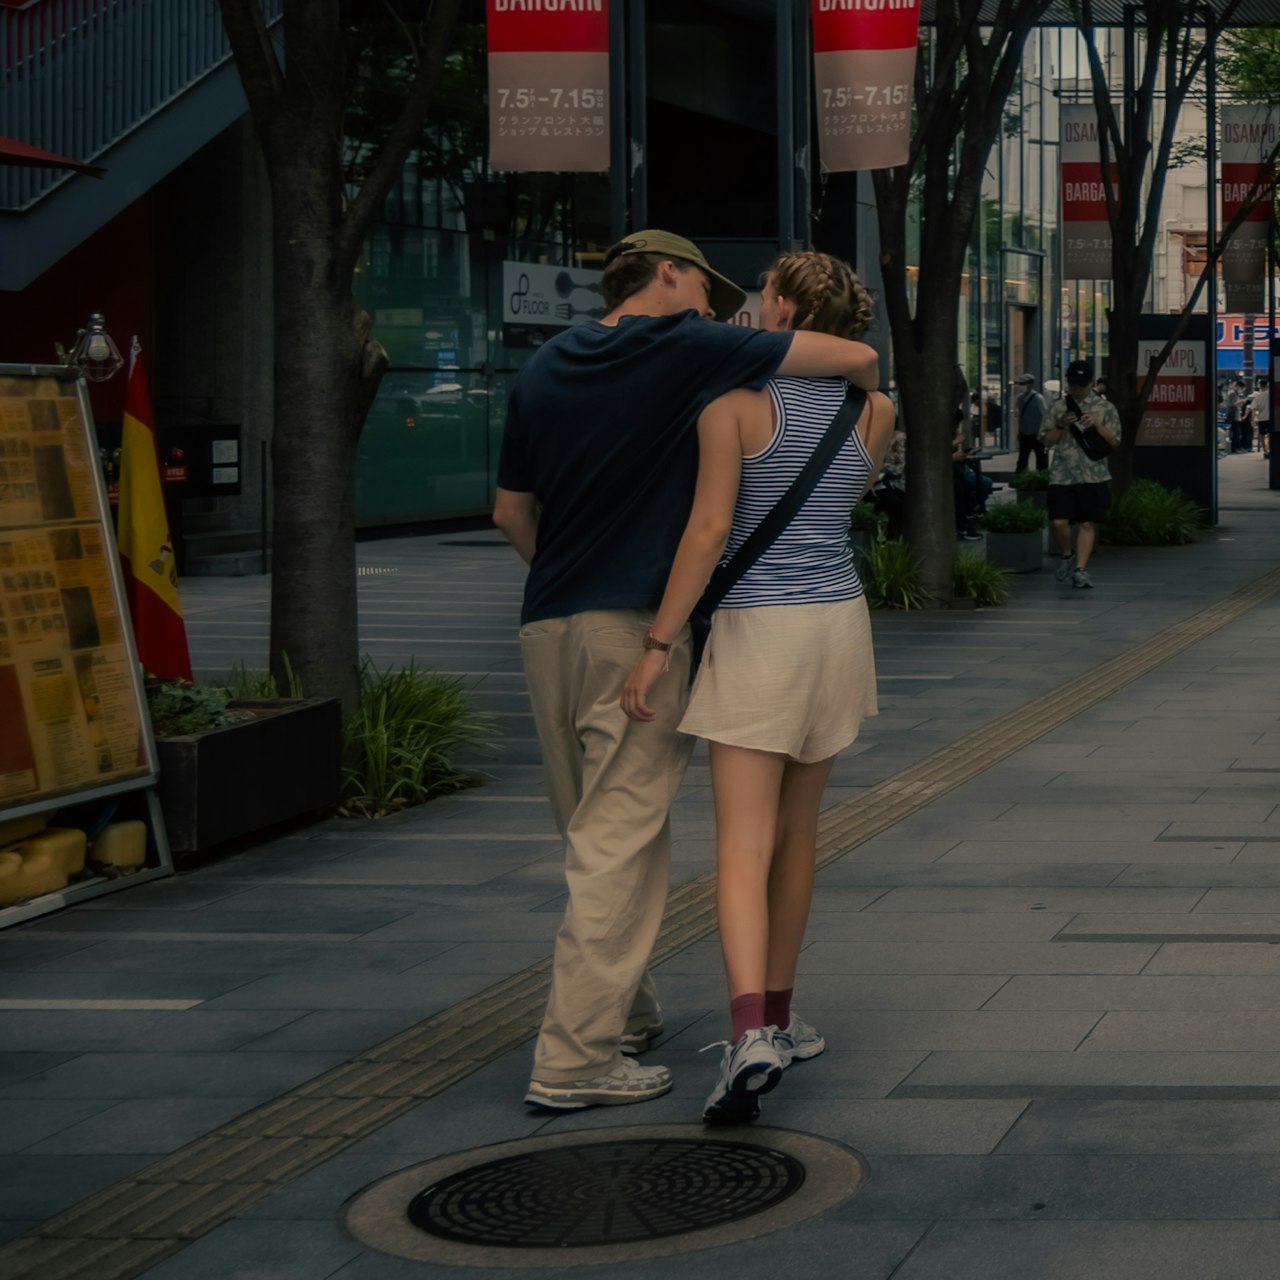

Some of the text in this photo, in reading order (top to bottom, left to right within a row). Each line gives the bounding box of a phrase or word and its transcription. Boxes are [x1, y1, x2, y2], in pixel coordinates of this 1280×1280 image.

[1065, 122, 1099, 143] OSAM
[1224, 123, 1276, 144] OSAMPO
[1065, 182, 1119, 202] BARGAN
[523, 299, 550, 315] FLOOR
